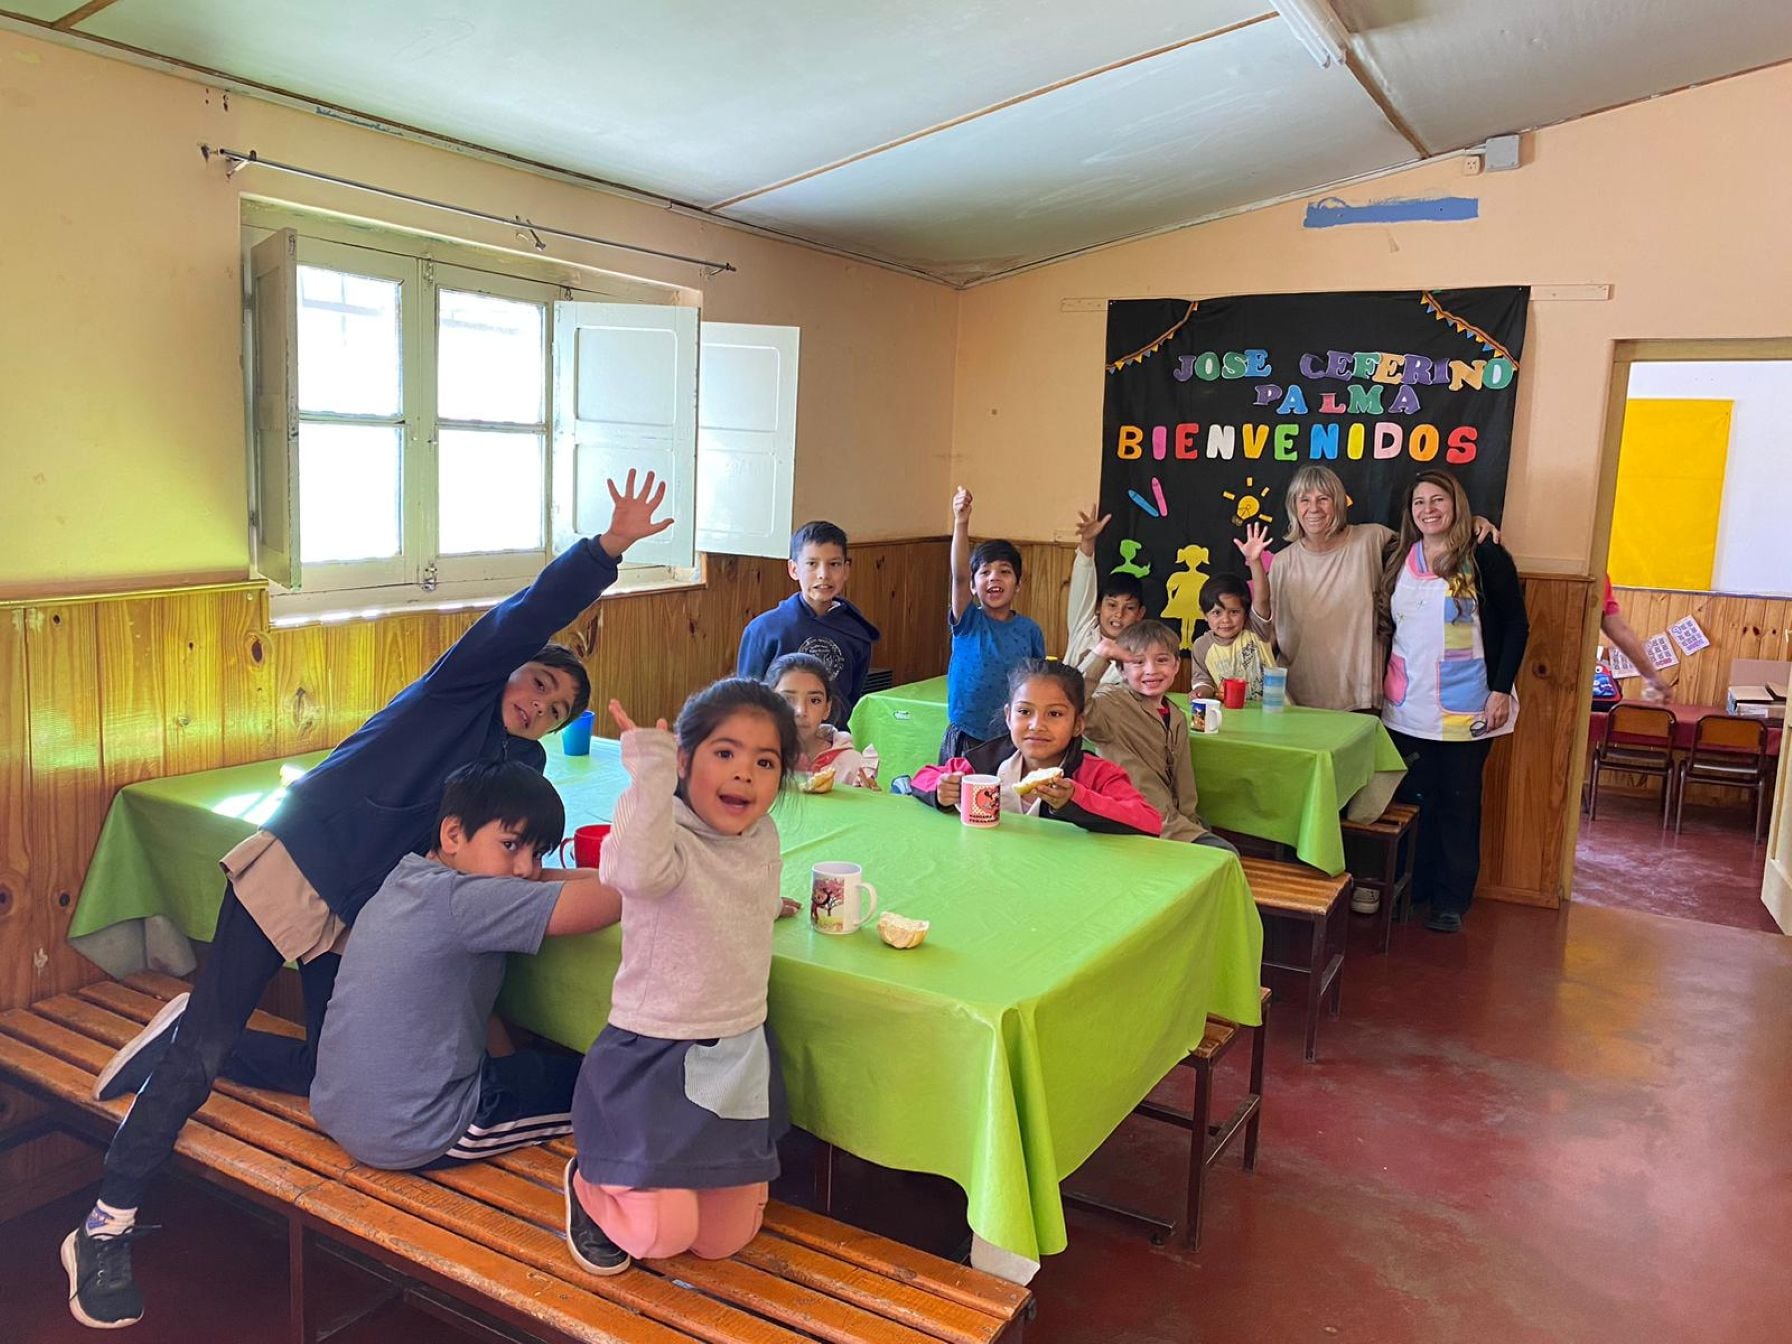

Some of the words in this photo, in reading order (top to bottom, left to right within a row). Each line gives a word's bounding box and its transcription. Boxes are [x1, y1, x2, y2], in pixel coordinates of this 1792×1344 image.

[1173, 349, 1272, 382] JOSE
[1300, 350, 1513, 391] CEFERINO
[1252, 384, 1422, 415] PALMA
[1118, 423, 1477, 463] BIENVENIDOS
